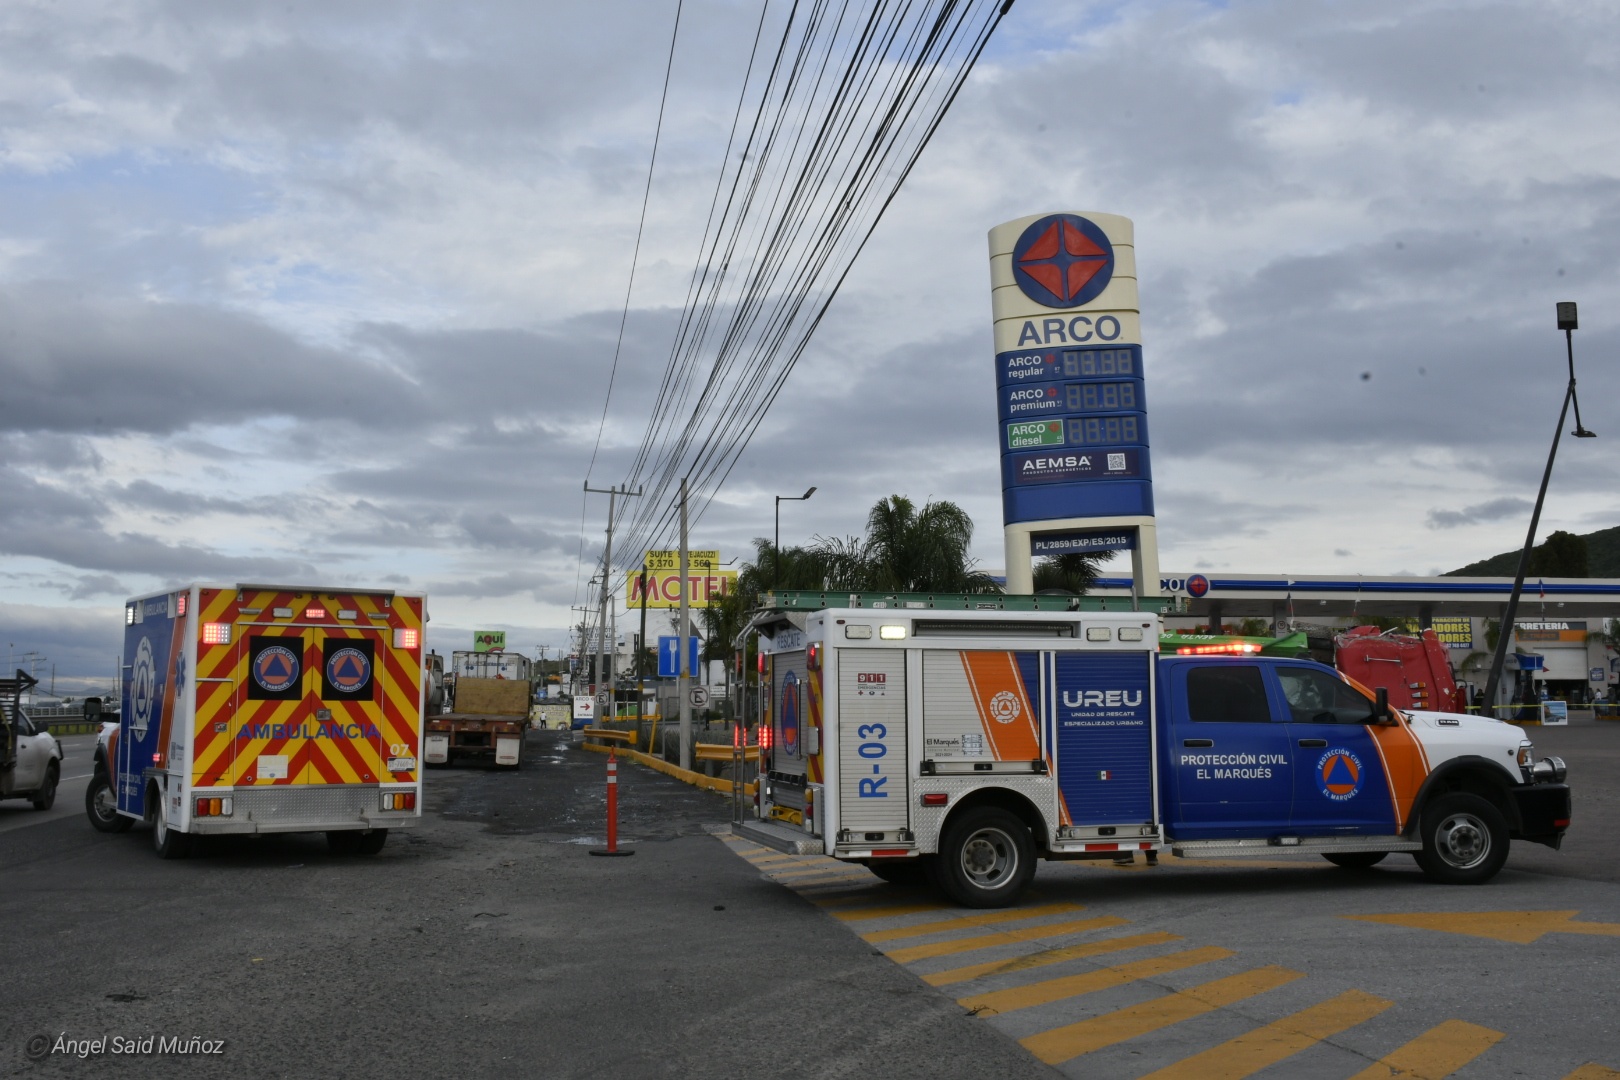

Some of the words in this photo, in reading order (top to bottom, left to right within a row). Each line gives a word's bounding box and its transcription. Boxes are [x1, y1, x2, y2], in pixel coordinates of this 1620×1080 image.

[1018, 315, 1121, 346] ARCO
[1008, 356, 1042, 368] ARCO
[1008, 367, 1044, 378] regular
[1010, 389, 1044, 400] ARCO
[1010, 400, 1056, 413] premium
[1012, 424, 1046, 436] ARCO
[1012, 435, 1042, 446] diesel
[1023, 456, 1091, 470] AEMSA
[1036, 536, 1126, 550] PL/2859/EXP/ES/2015
[1160, 578, 1180, 591] CO
[1514, 622, 1569, 630] RRETERIA
[476, 633, 503, 645] AQUÍ
[777, 632, 801, 649] RESCATE
[858, 673, 885, 682] 911
[1063, 690, 1142, 708] UREU
[236, 723, 382, 740] AMBULANCIA
[934, 738, 959, 747] Marqués
[389, 744, 409, 756] 07
[858, 723, 888, 797] R-03
[1181, 753, 1256, 765] PROTECCIÓN
[1259, 755, 1288, 765] CIVIL
[1318, 748, 1350, 770] PROTECCIÓN
[1350, 754, 1363, 770] CIVIL
[1197, 769, 1211, 779] EL
[1214, 766, 1272, 779] MARQUÉS
[1323, 788, 1329, 796] EL
